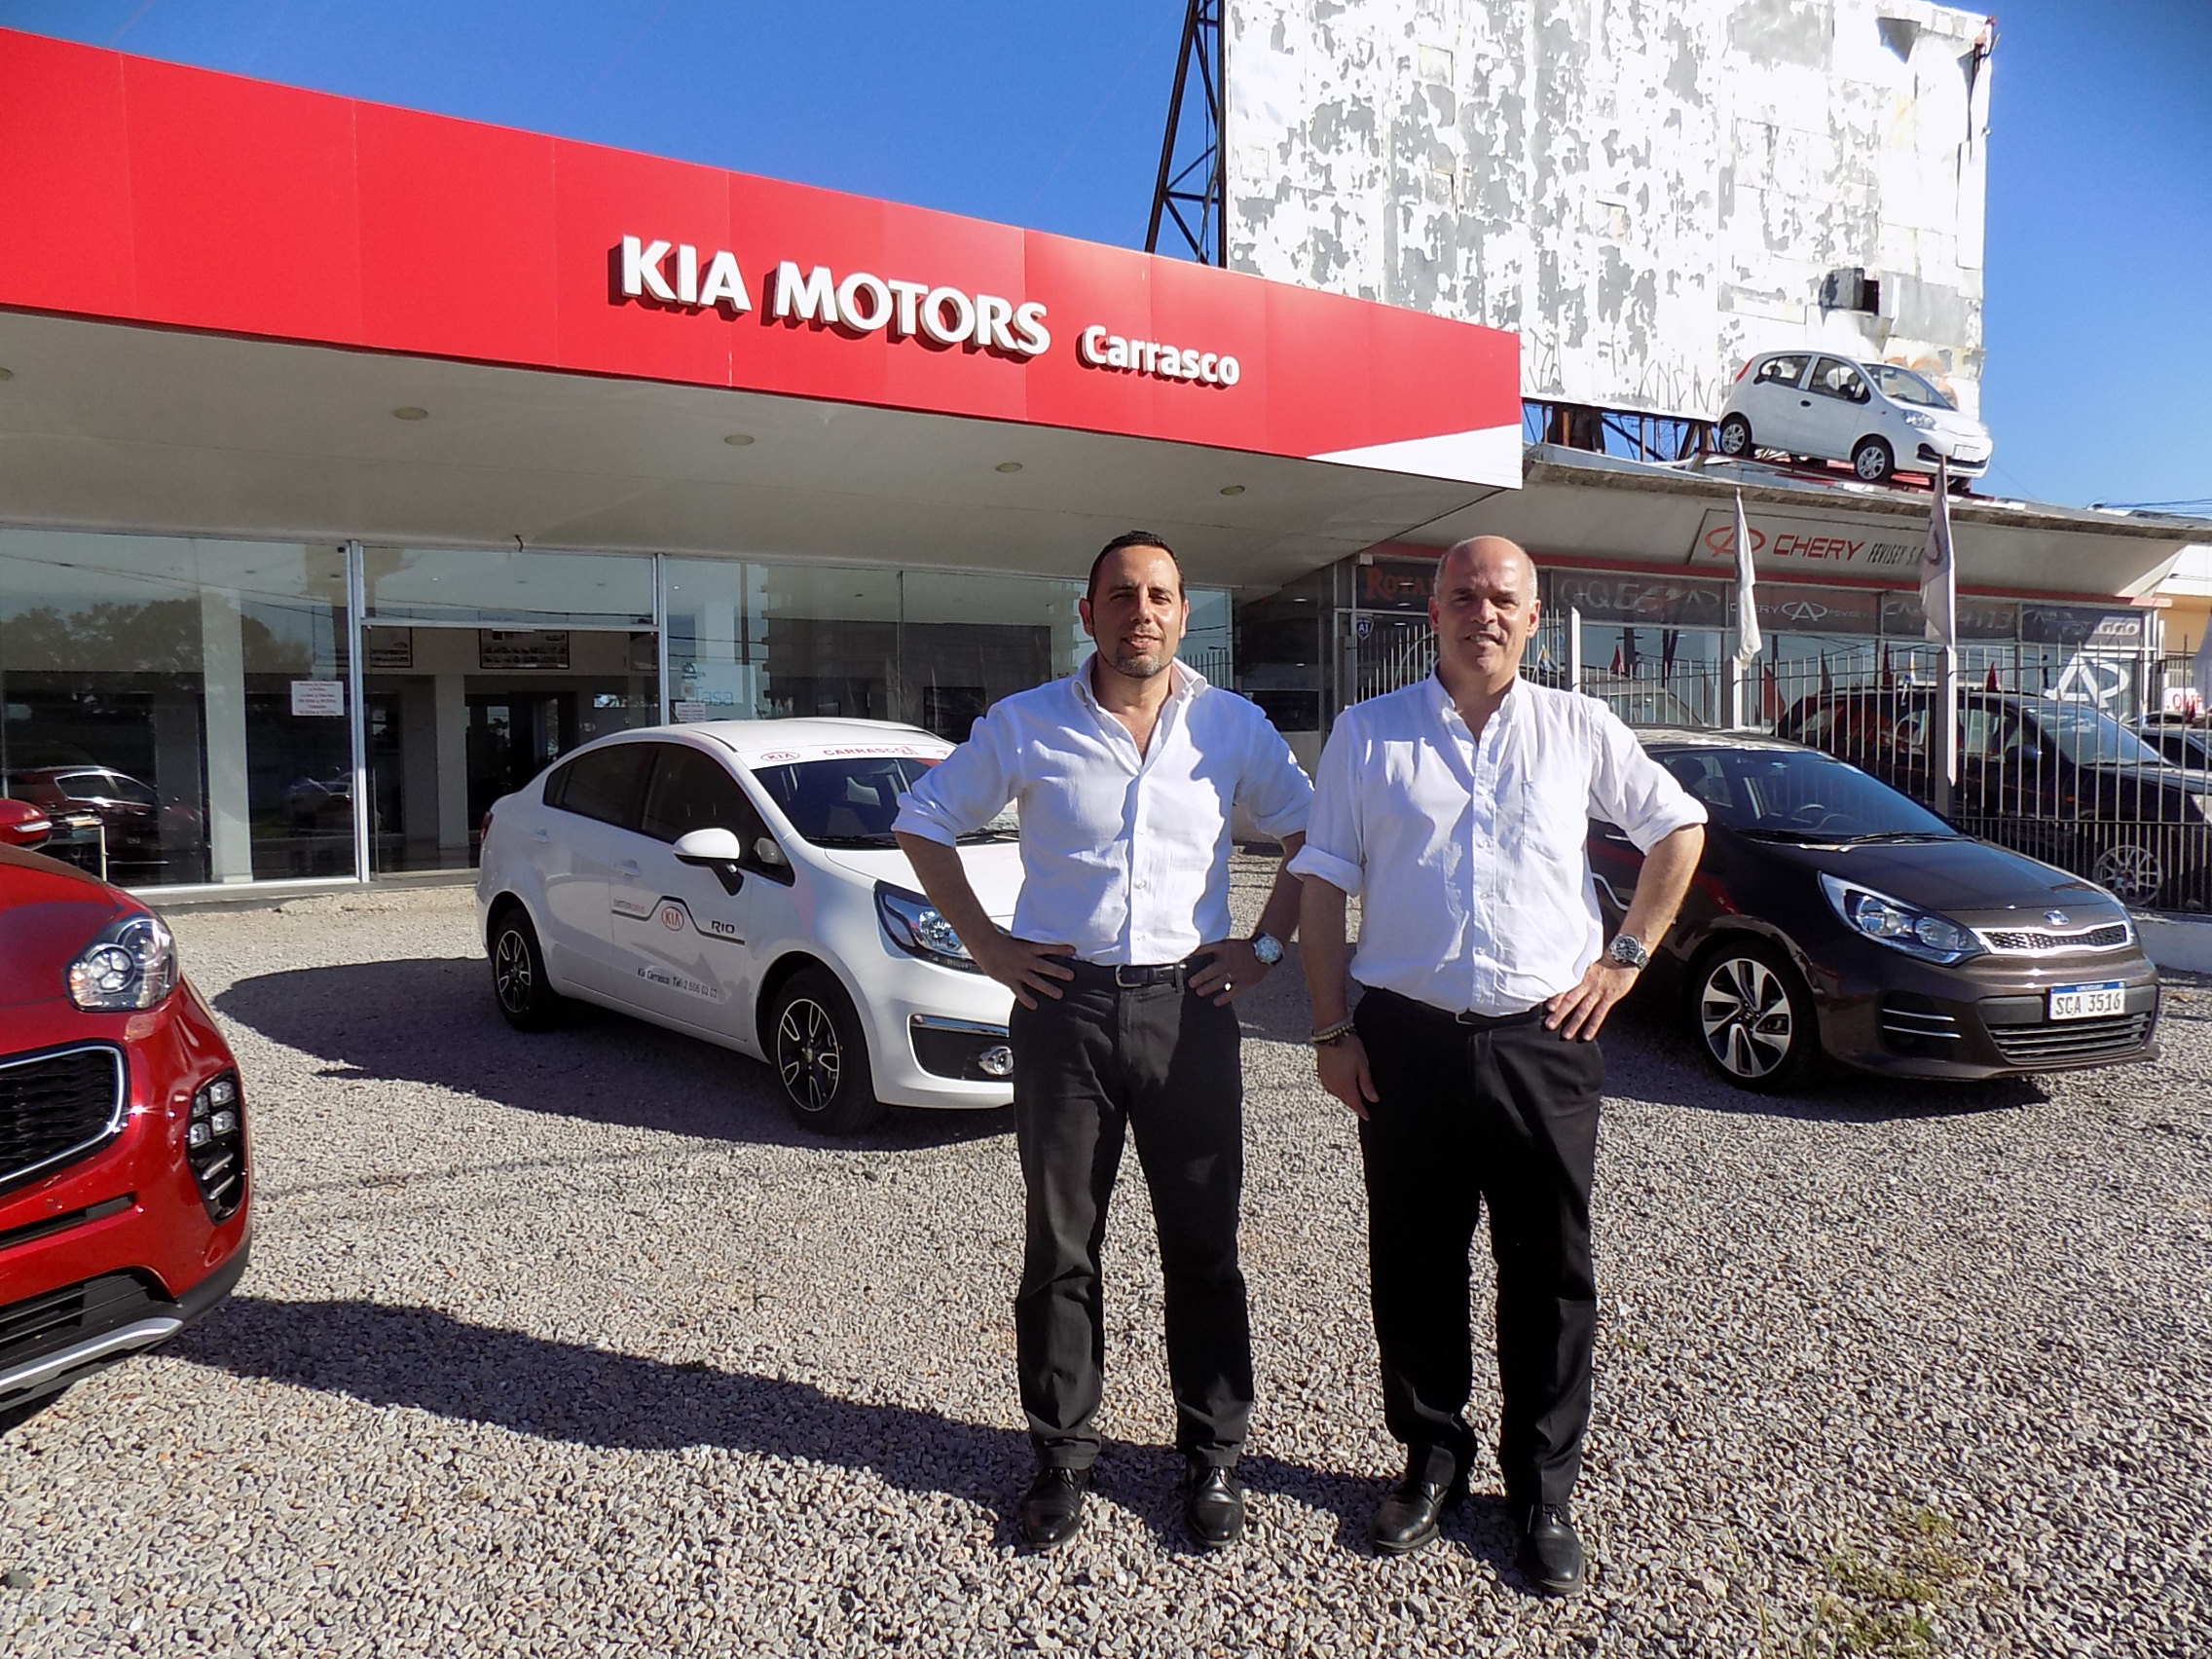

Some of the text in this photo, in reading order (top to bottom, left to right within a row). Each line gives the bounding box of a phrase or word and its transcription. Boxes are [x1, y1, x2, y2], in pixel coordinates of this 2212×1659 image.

[621, 234, 1240, 387] KIA MOTORS Carrasco
[1773, 534, 1865, 561] CHERY
[1730, 603, 1780, 614] CRY
[767, 752, 795, 761] KIA
[665, 911, 681, 927] KIA
[711, 920, 735, 935] RIO
[2088, 992, 2121, 1014] 3516
